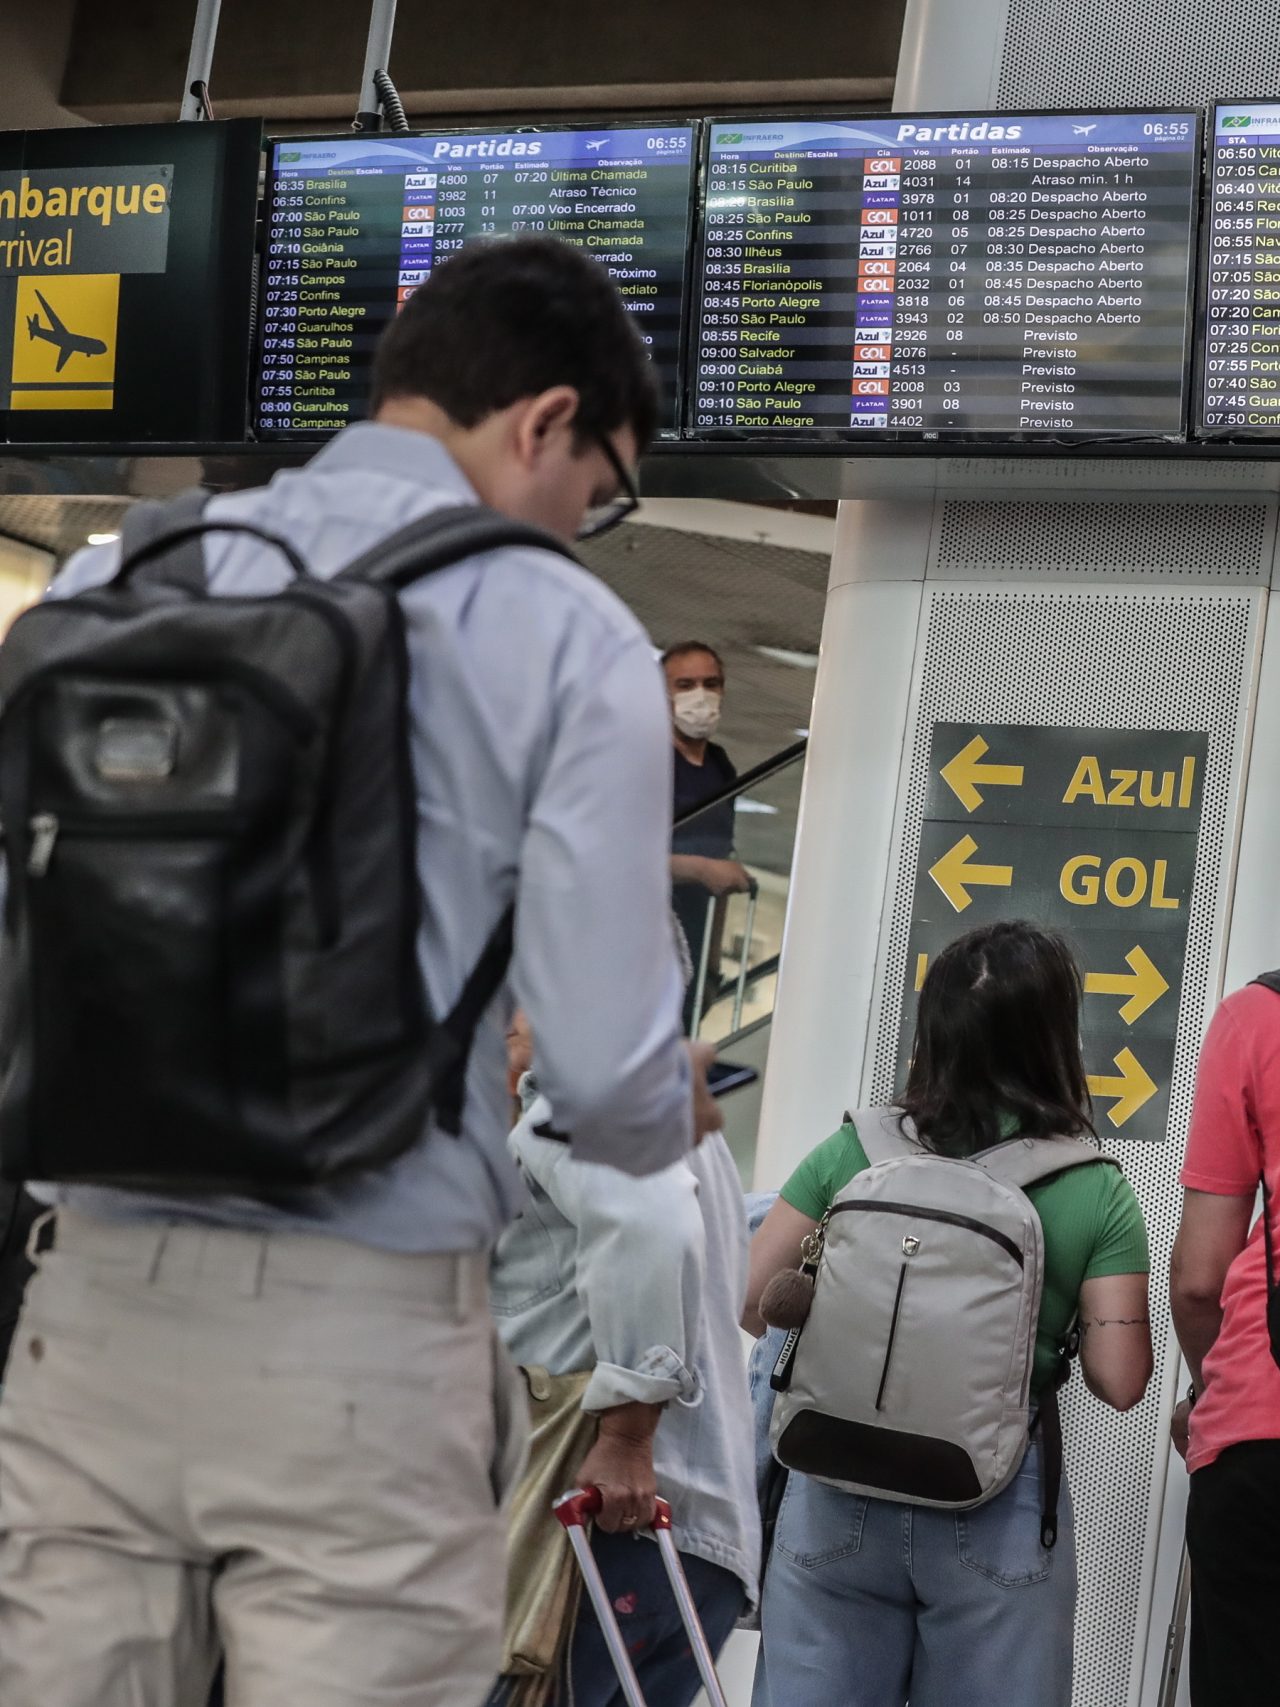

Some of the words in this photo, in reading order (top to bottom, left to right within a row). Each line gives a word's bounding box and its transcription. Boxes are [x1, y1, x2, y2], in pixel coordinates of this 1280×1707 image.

[897, 124, 1022, 141] Partidas
[1144, 123, 1188, 135] 06:55
[433, 139, 542, 158] Partidas
[647, 137, 686, 149] 06:55
[1218, 149, 1255, 159] 06:50
[712, 164, 746, 174] 08:15
[749, 164, 797, 173] Curitiba
[870, 161, 896, 172] GOL
[904, 160, 936, 171] 2088
[956, 159, 971, 170] 01
[991, 158, 1029, 168] 08:15
[1033, 156, 1100, 171] Despacho
[1105, 156, 1149, 168] Aberto
[274, 181, 304, 191] 06:35
[306, 180, 347, 189] Brasília
[406, 178, 426, 186] Azul
[439, 175, 467, 185] 4800
[484, 174, 498, 183] 07
[515, 172, 547, 182] 07:20
[550, 170, 588, 181] Última
[591, 169, 648, 180] Chamada
[711, 181, 745, 190] 08:15
[749, 180, 773, 189] São
[777, 179, 813, 189] Paulo
[864, 179, 887, 188] Azul
[903, 177, 934, 187] 4031
[957, 177, 970, 187] 14
[1032, 174, 1075, 186] Atraso
[1125, 173, 1133, 184] h
[273, 197, 303, 206] 06:55
[305, 196, 346, 205] Confins
[439, 191, 467, 201] 3982
[484, 190, 496, 199] 11
[549, 188, 587, 198] Atraso
[591, 186, 637, 196] Técnico
[1216, 184, 1254, 194] 06:40
[272, 213, 302, 222] 07:00
[304, 211, 326, 221] São
[329, 211, 360, 220] Paulo
[408, 209, 431, 218] GOL
[438, 207, 465, 217] 1003
[482, 206, 495, 216] 01
[513, 205, 545, 215] 07:00
[549, 203, 572, 214] Voo
[576, 203, 635, 213] Encerrado
[1214, 237, 1252, 247] 06:55
[1213, 254, 1251, 264] 07:15
[705, 281, 740, 290] 08:45
[743, 280, 823, 292] Florianópolis
[864, 280, 890, 290] GOL
[897, 279, 929, 289] 2032
[949, 279, 964, 289] 01
[985, 279, 1022, 289] 08:45
[1027, 278, 1094, 291] Despacho
[1098, 278, 1143, 289] Aberto
[266, 307, 296, 317] 07:30
[299, 307, 327, 316] Porto
[330, 306, 365, 317] Alegre
[1211, 308, 1249, 318] 07:20
[703, 331, 737, 341] 08:55
[740, 331, 780, 340] Recife
[856, 332, 879, 340] Azul
[895, 330, 927, 341] 2926
[946, 330, 963, 341] 08
[1024, 330, 1078, 341] Previsto
[261, 403, 291, 412] 08:00
[293, 402, 349, 411] Guarulhos
[1062, 756, 1196, 808] Azul
[1059, 854, 1179, 908] GOL
